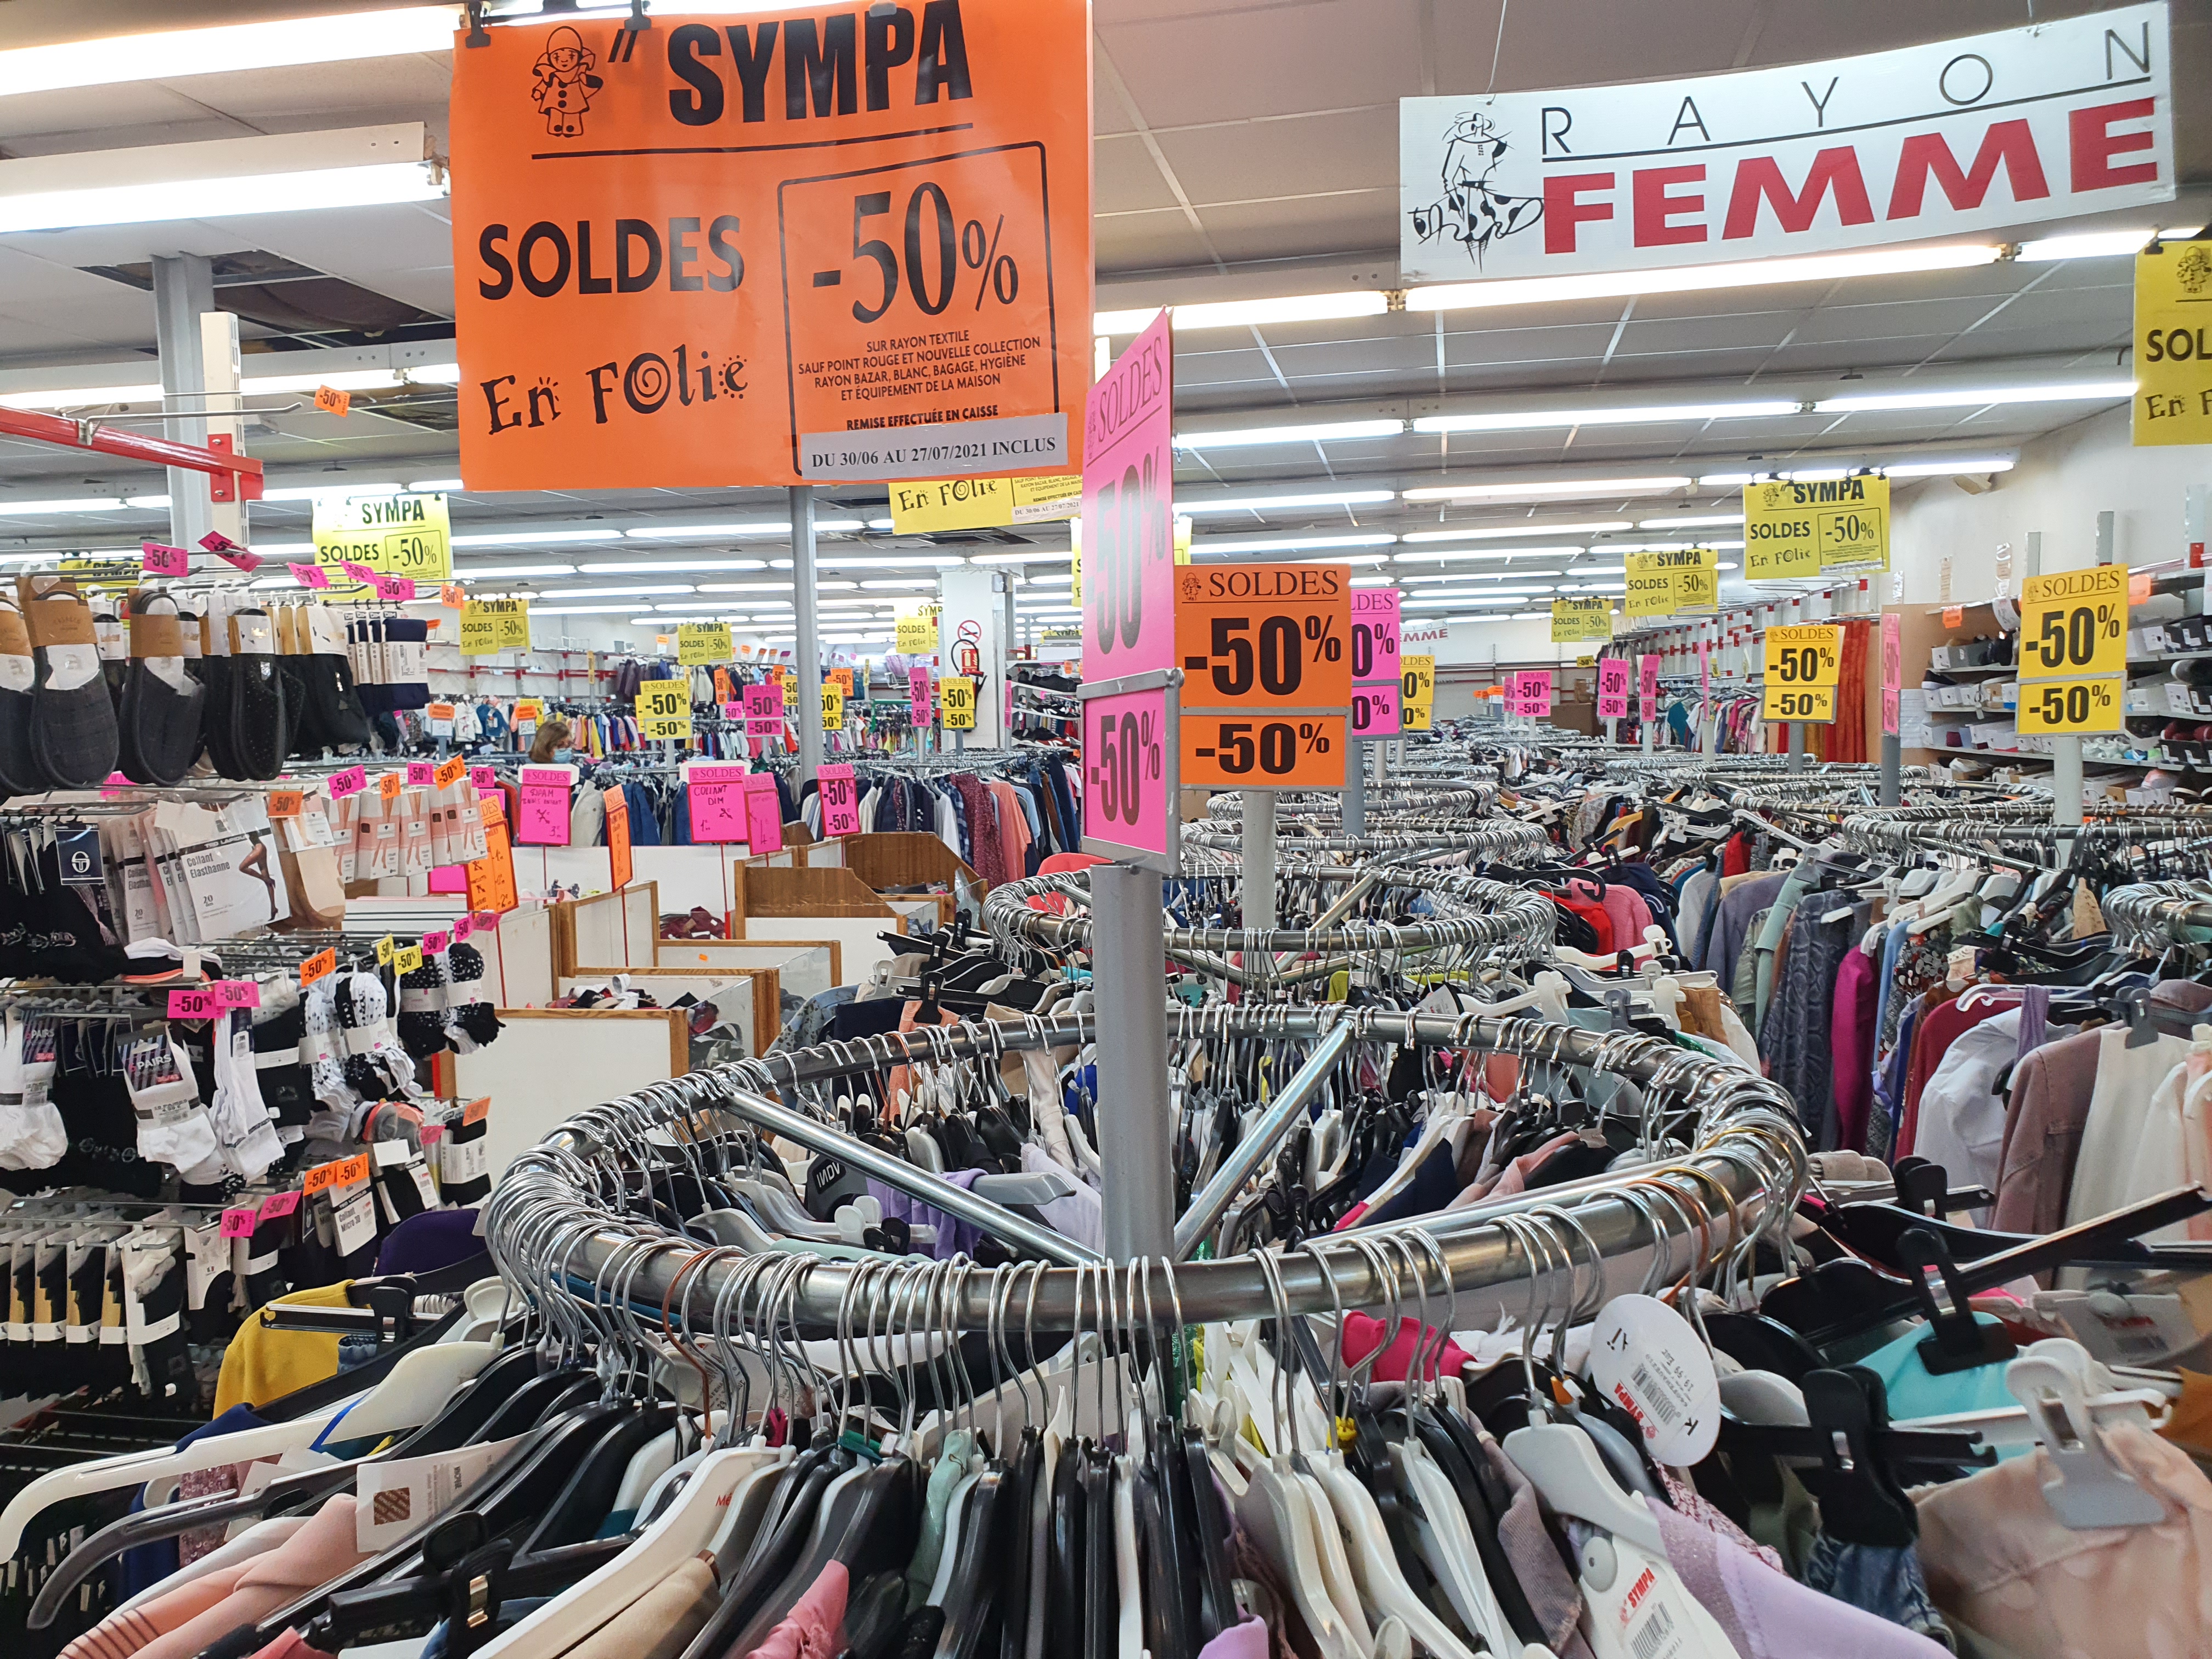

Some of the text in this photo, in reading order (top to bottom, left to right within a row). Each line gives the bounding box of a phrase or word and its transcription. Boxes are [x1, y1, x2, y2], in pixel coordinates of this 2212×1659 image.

[668, 0, 973, 127] SYMPA
[1541, 20, 2151, 156] RAYON
[1542, 97, 2158, 255] FEMME
[478, 215, 744, 301] SOLDES
[812, 182, 1019, 324] -50%
[866, 330, 969, 353] SUR RAYON TEXTILE
[2146, 329, 2212, 362] SOL
[798, 336, 1041, 375] SAUF POINT ROUGE ET NOUVELLE COLLECTION
[815, 354, 1025, 388] RAYON BAZAR, BLANC, BAGAGE, HYGIÈNE
[841, 374, 1000, 401] ET ÉQUIPEMENT DE LA MAISON
[1098, 336, 1163, 443] SOLDES
[479, 374, 560, 435] En
[2145, 393, 2185, 420] En
[847, 404, 998, 430] REMISE EFFECTUÉE EN CAISSE
[812, 437, 1056, 468] DU 30/06 AU 27/07/2021 INCLUS
[898, 490, 930, 512] En
[1793, 479, 1865, 504] SYMPA
[362, 500, 425, 524] SYMPA
[1750, 521, 1810, 539] SOLDES
[1825, 515, 1874, 543] -50%
[320, 544, 379, 563] SOLDES
[393, 537, 437, 567] -50%
[1657, 552, 1701, 567] SYMPA
[1209, 569, 1339, 597] SOLDES
[1628, 578, 1668, 590] SOLDES
[1678, 574, 1708, 592] -50%
[2042, 570, 2120, 598] SOLDES
[483, 601, 517, 612] SYMPA
[918, 605, 943, 616] SYMP
[1572, 601, 1602, 610] SYMPA
[462, 623, 492, 632] SOLDES
[697, 624, 723, 633] SYMPA
[1400, 629, 1448, 642] MME
[1781, 628, 1833, 640] SOLDES
[2025, 603, 2120, 668] -50%
[1184, 614, 1341, 696] -50%
[1351, 622, 1395, 678] 0%
[1769, 647, 1834, 681] -50%
[651, 681, 685, 690] SOLDES
[782, 682, 797, 693] -50
[912, 680, 929, 702] -50%
[1404, 672, 1430, 699] 0%
[1517, 681, 1549, 698] -50%
[1601, 672, 1626, 693] -50%
[645, 693, 686, 715] -50%
[747, 696, 781, 715] -50%
[943, 689, 972, 708] -50%
[1519, 703, 1546, 713] -50%
[1771, 693, 1827, 715] -50%
[2029, 684, 2111, 725] -50%
[822, 717, 839, 727] 50%
[946, 714, 972, 726] -50%
[1351, 693, 1390, 730] 0%
[1403, 708, 1425, 725] 0%
[650, 721, 686, 736] -50%
[750, 721, 780, 733] -50%
[1195, 723, 1330, 775] -50%
[439, 764, 457, 782] -50%
[533, 771, 568, 781] SOLDES
[701, 769, 741, 778] SOLDES
[1091, 709, 1160, 826] -50%
[334, 773, 357, 792] -50%
[823, 780, 853, 805] -50%
[829, 813, 854, 830] -50%
[187, 853, 213, 867] Collant
[190, 861, 230, 879] Elasthanne
[305, 957, 326, 978] -50%
[175, 996, 212, 1012] -50%
[137, 1054, 171, 1070] PAIRS
[1614, 1383, 1644, 1423] SYMPA
[1628, 1568, 1655, 1607] SYMPA
